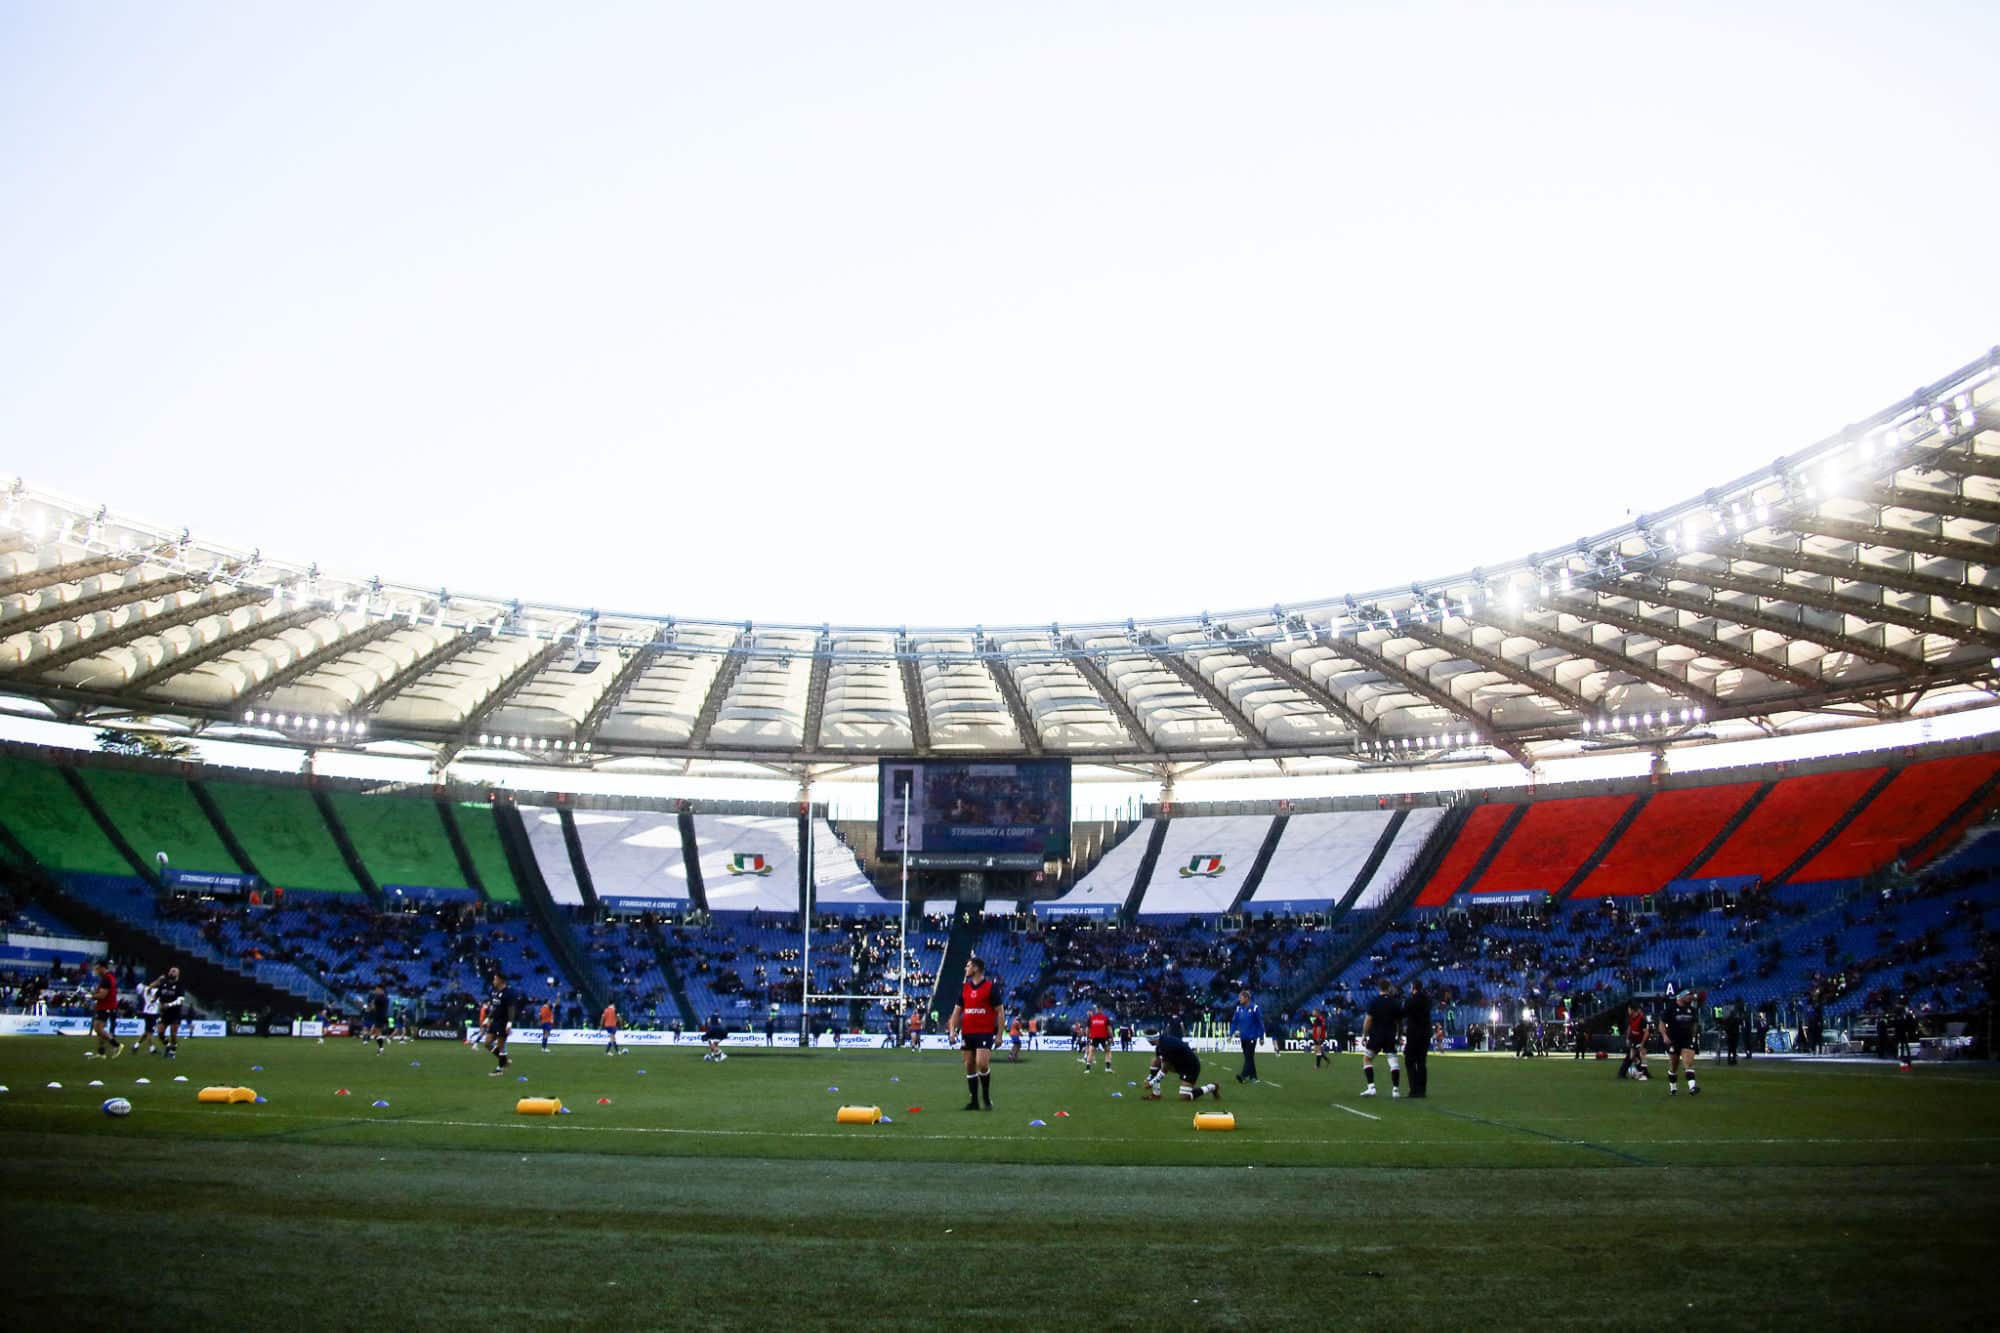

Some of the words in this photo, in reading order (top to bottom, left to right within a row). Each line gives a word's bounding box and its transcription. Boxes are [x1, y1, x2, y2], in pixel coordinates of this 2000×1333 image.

[1666, 982, 1675, 995] A
[418, 1027, 459, 1040] GUINNESS
[1043, 1038, 1072, 1047] KingsB
